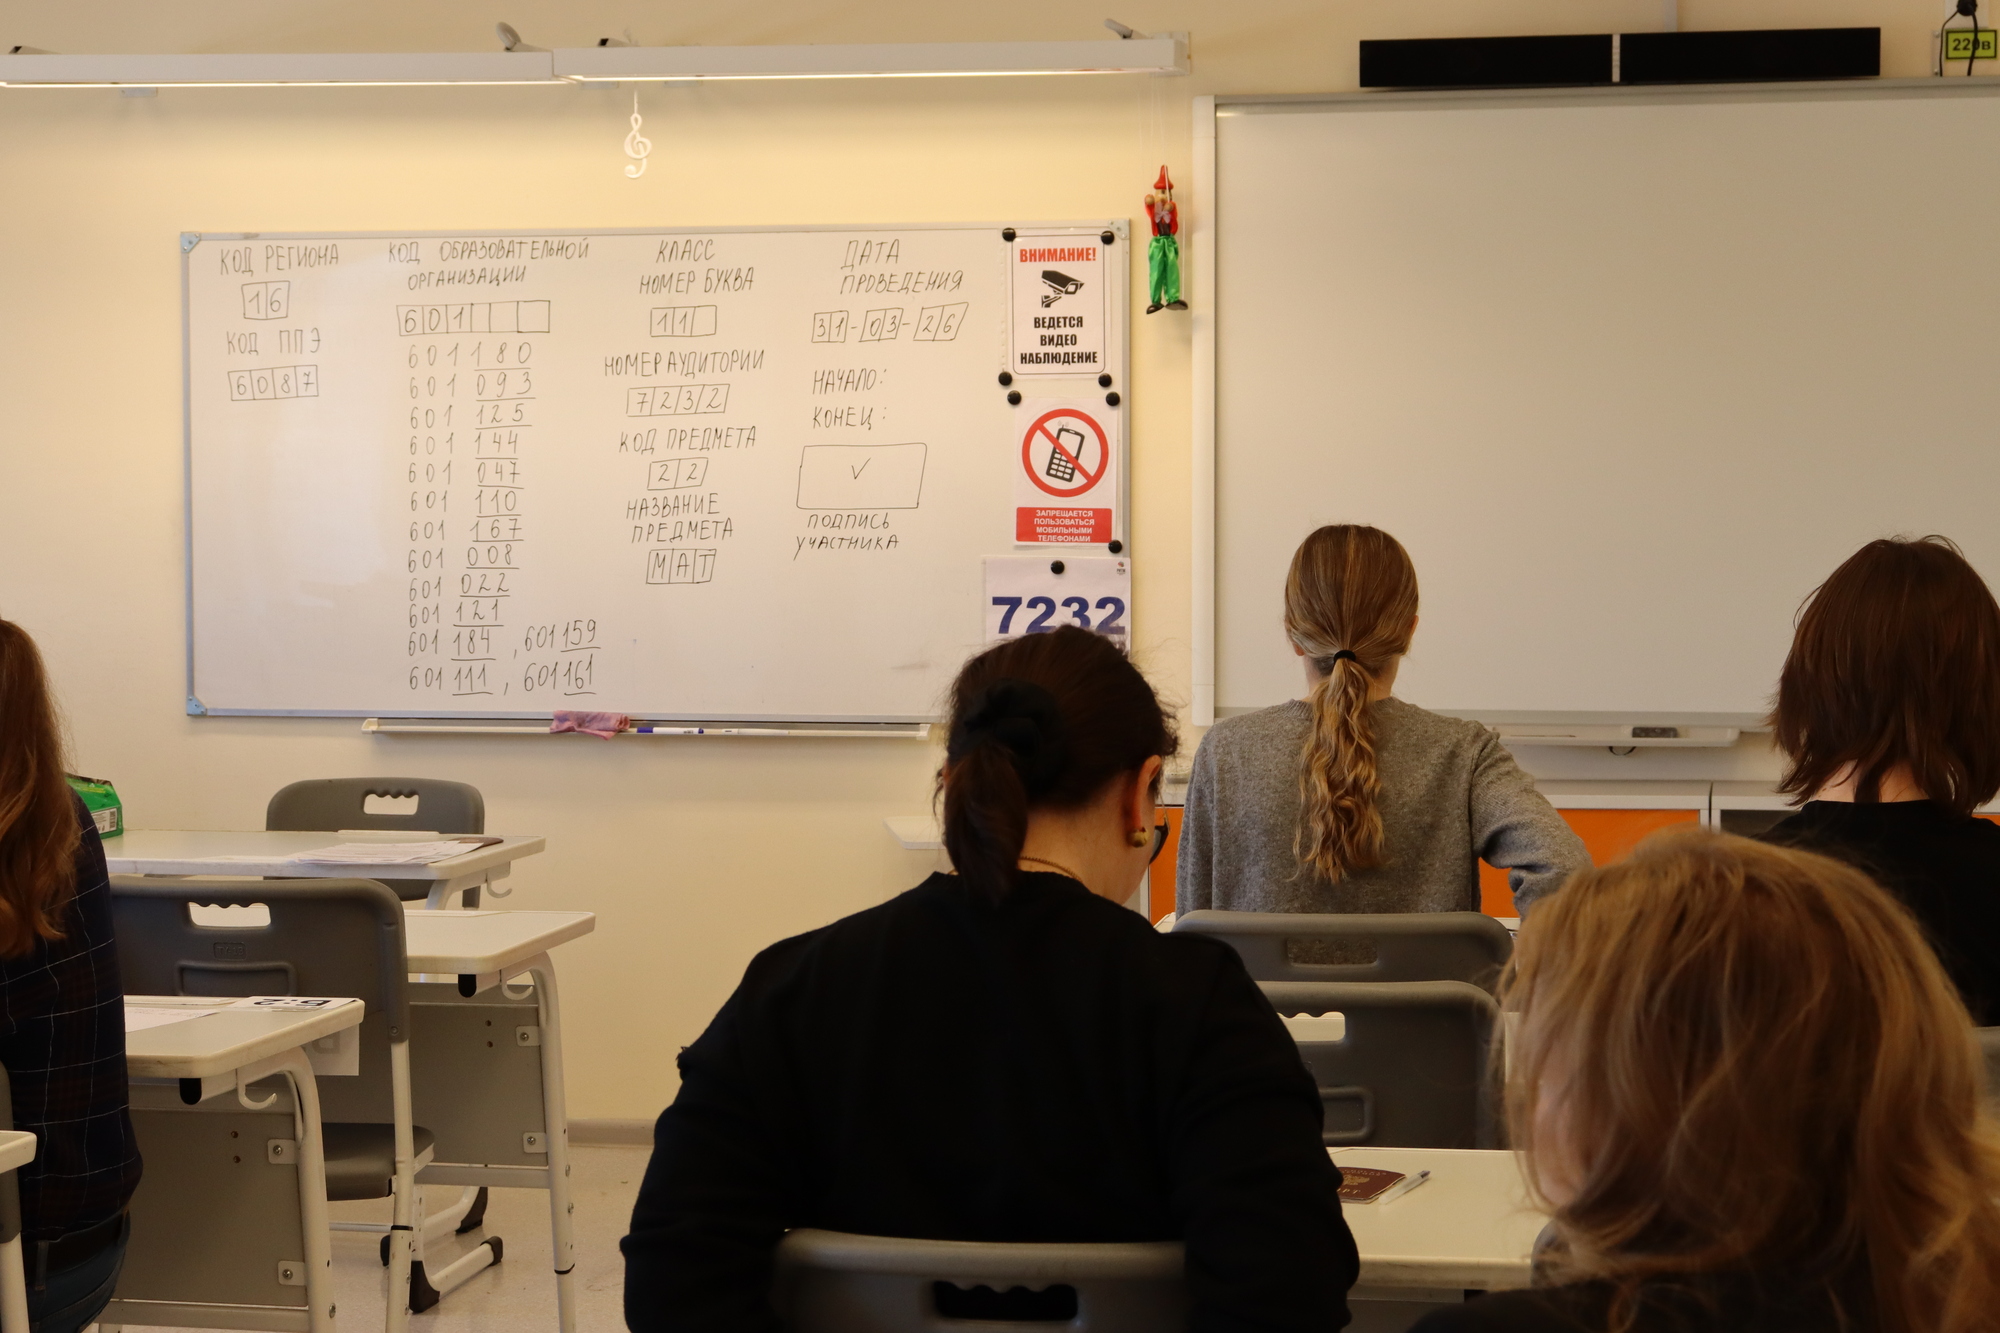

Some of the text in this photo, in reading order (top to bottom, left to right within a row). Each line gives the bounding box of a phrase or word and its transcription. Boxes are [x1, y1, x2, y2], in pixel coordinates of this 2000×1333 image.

[219, 243, 339, 277] КОД РЕГИОНА
[388, 237, 589, 265] КОД ОБРАЗОВАТЕЛЬНОЙ
[655, 238, 716, 263] КЛАСС
[840, 238, 900, 272] ДАТА
[1019, 246, 1097, 263] ВНИМАНИЕ!
[407, 264, 527, 291] ОРГАНИЗАЦИИ
[639, 266, 755, 295] НОМЕР БУКВА
[839, 269, 964, 295] ПРОВЕДЕНИЯ
[248, 287, 282, 315] 16
[404, 306, 464, 334] 601
[656, 310, 688, 334] 11
[1033, 315, 1084, 331] ВЕДЕТСЯ
[226, 327, 321, 356] КОД ППЭ
[1039, 333, 1078, 348] ВИДЕО
[1019, 351, 1098, 366] НАБЛЮДЕНИЕ
[236, 370, 315, 396] 6087
[812, 367, 887, 395] НАЧАЛО:
[636, 387, 722, 414] 7232
[618, 425, 756, 456] КОД ПРЕДМЕТА
[657, 462, 698, 483] 22
[625, 492, 721, 521] НАЗВАНИЕ
[1035, 509, 1094, 518] ЗАПРЕЩАЕТСЯ
[631, 517, 734, 544] ПРЕДМЕТА
[807, 512, 890, 530] ПОДПИСЬ
[1033, 517, 1095, 526] ПОЛЬЗОВАТЬСЯ
[1035, 526, 1093, 534] МОБИЛЬНЫМИ
[793, 533, 900, 562] УЧАСТНИКА
[1037, 534, 1091, 542] ТЕЛЕФОНАМИ
[651, 552, 717, 580] МАТ
[991, 595, 1126, 635] 7232
